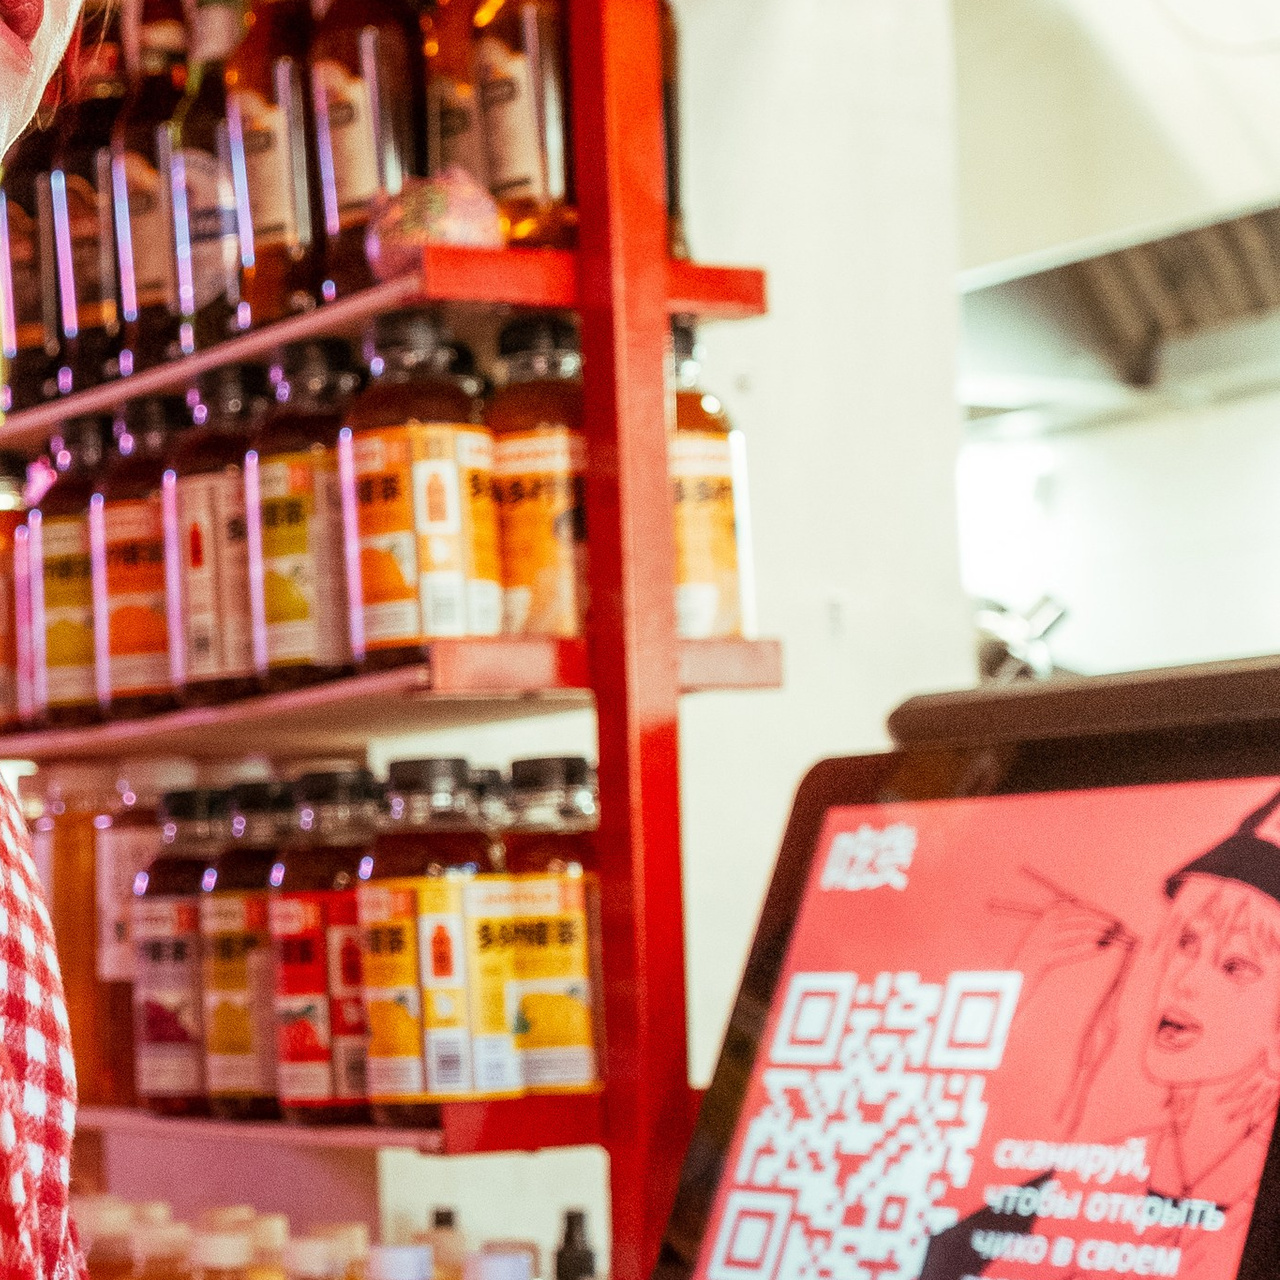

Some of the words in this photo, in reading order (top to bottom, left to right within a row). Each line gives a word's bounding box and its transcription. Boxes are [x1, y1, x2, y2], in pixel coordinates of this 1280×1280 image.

[984, 1180, 1082, 1219] чтобы
[1086, 1192, 1225, 1234] открыть
[1077, 1240, 1182, 1277] своем
